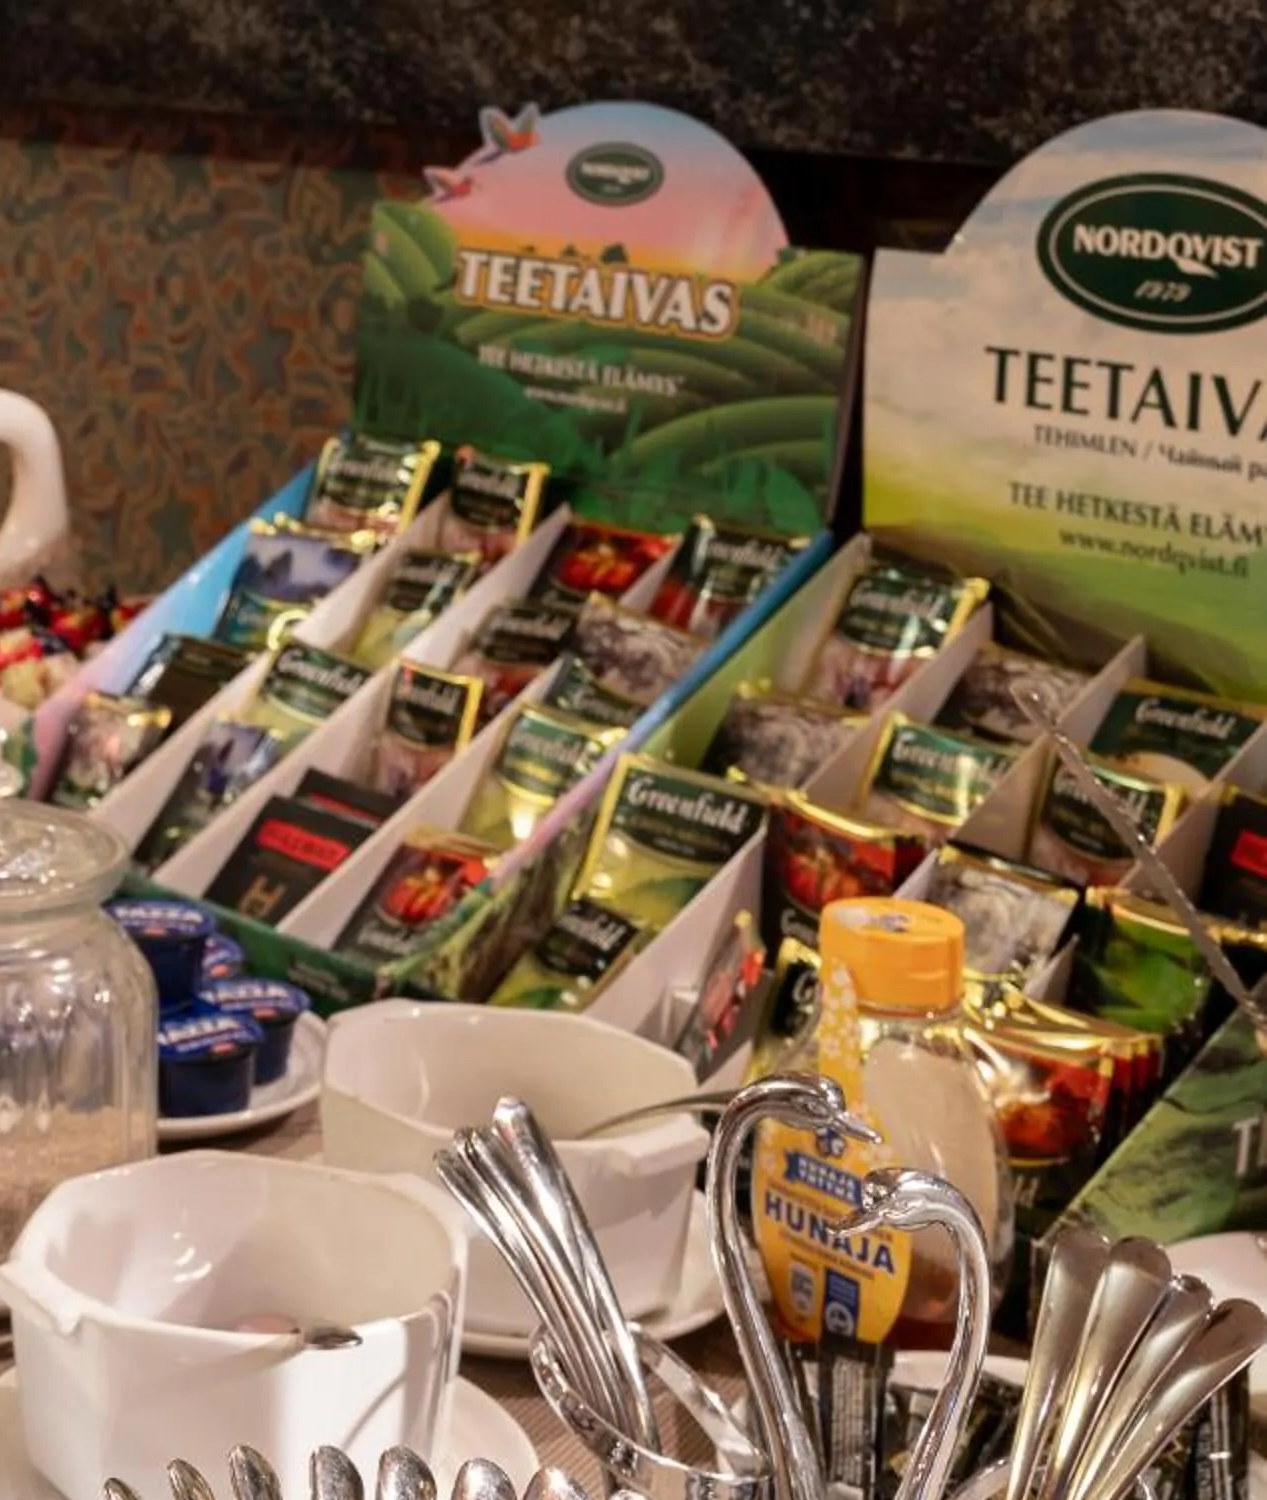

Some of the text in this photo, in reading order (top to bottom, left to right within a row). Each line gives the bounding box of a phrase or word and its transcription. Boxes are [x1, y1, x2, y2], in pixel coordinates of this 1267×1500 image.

[1073, 223, 1264, 275] NORDQVIST
[459, 251, 733, 334] TEETAIVAS
[1009, 481, 1267, 548] TEE HETKESTÄ ELÄM
[1059, 528, 1250, 579] www.nordqvist.fi
[627, 776, 749, 835] Greenfield
[764, 1189, 895, 1275] HUNAJA
